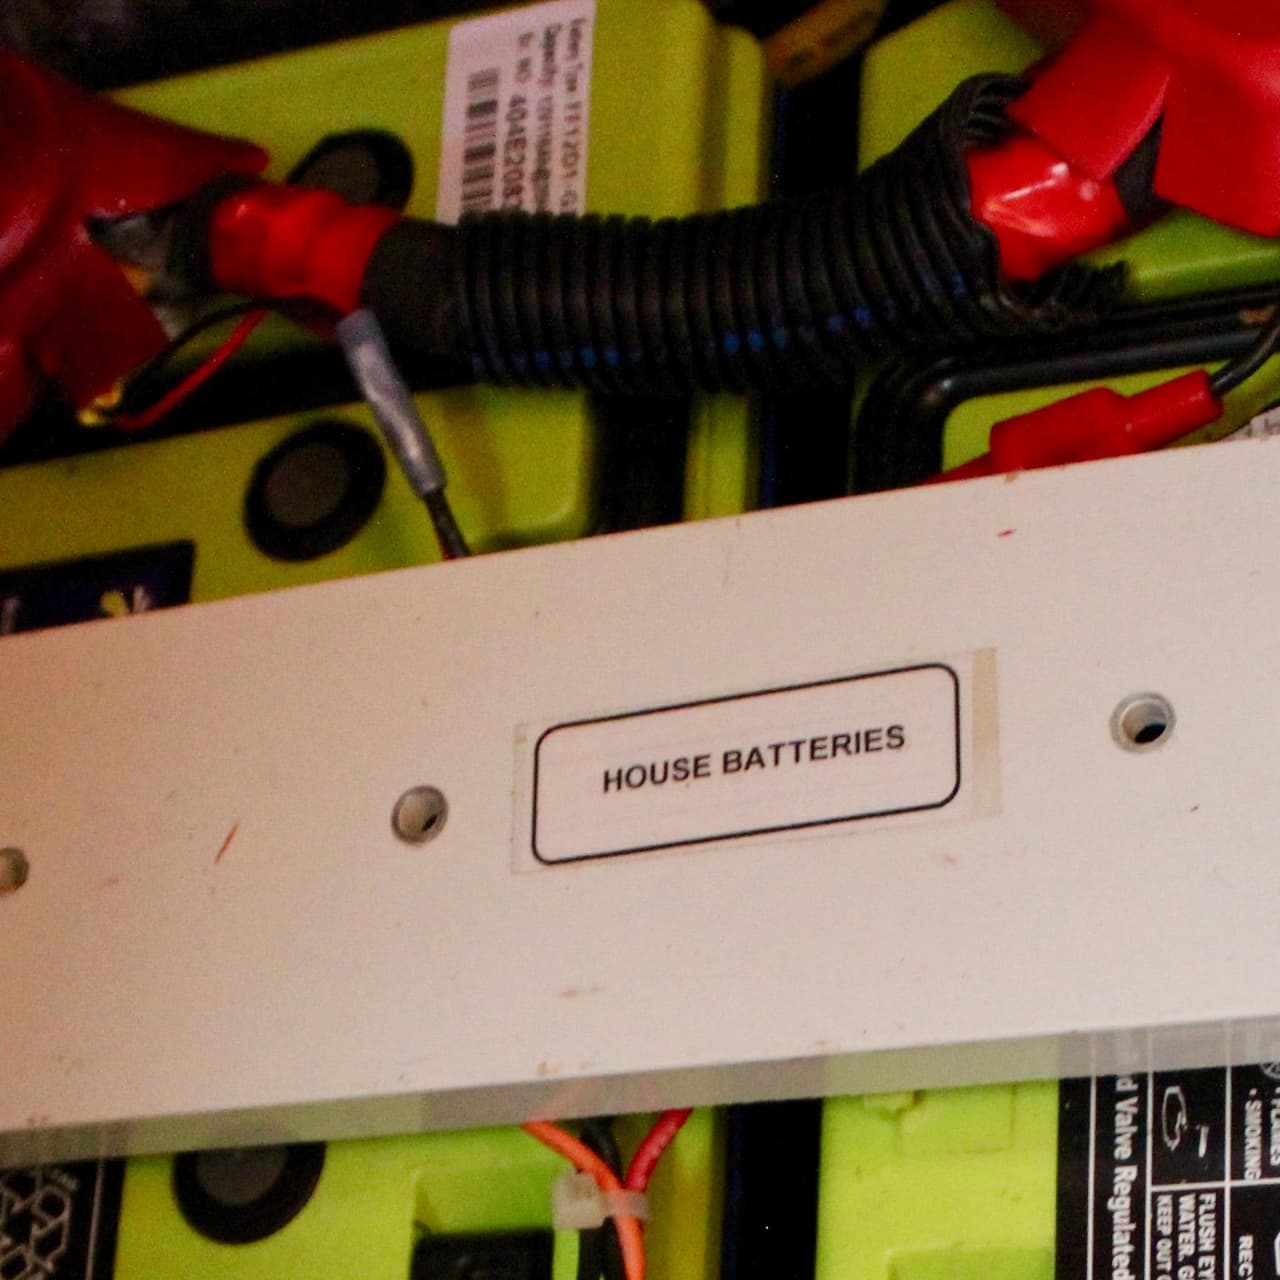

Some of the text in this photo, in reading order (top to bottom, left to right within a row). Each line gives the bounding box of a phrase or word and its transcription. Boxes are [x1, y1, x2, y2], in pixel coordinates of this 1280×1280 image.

[602, 724, 906, 794] HOUSE BATTERIES
[1113, 1099, 1137, 1159] Valve
[1243, 1099, 1262, 1180] SMOKING
[1153, 1195, 1171, 1234] KEEP
[1196, 1193, 1215, 1252] FLUSH
[1153, 1238, 1171, 1270] OUT
